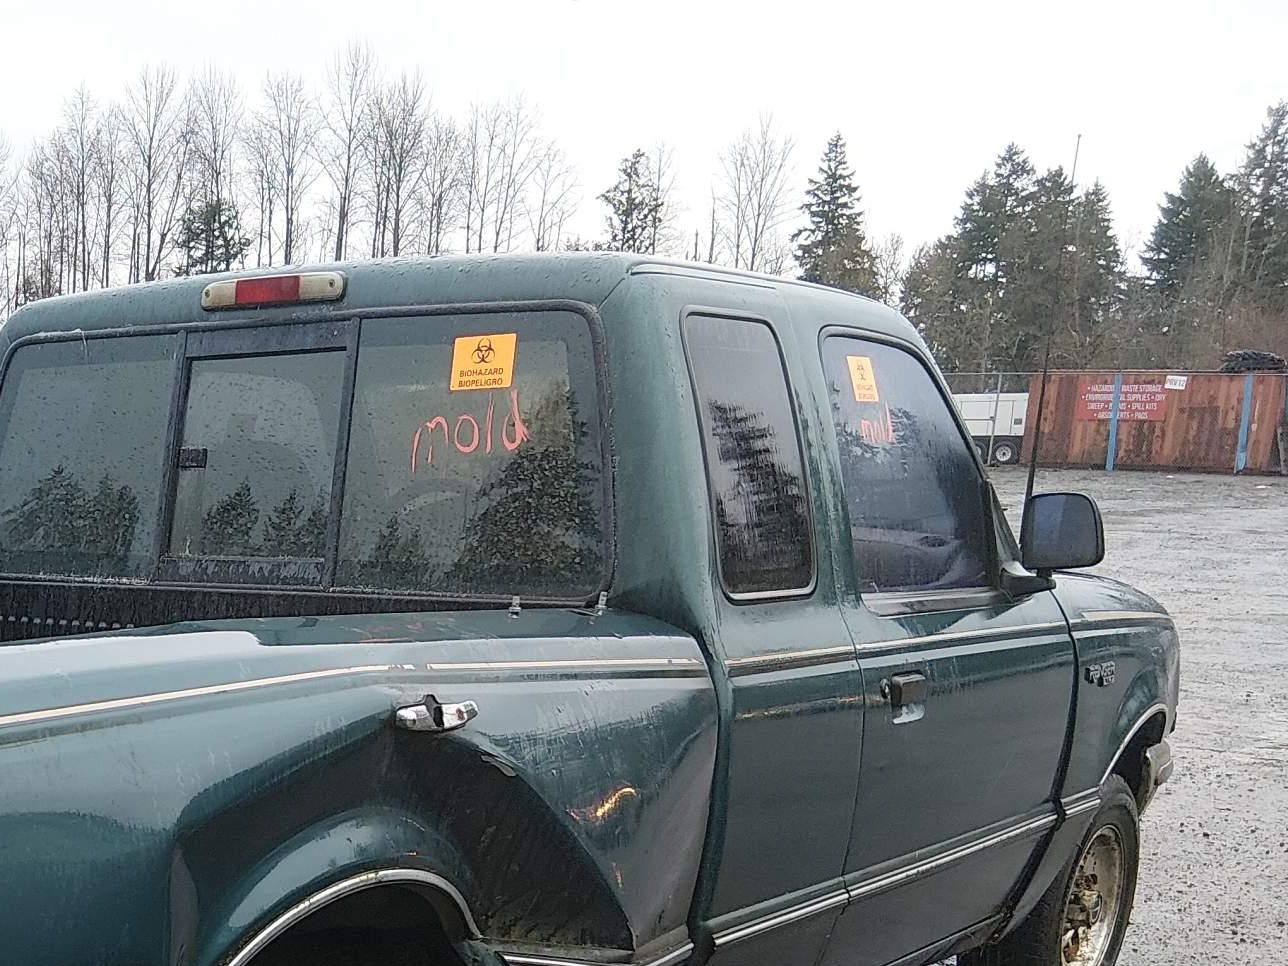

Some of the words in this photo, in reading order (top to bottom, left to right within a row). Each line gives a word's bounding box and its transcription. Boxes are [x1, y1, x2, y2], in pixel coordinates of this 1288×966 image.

[459, 367, 504, 378] BIOHAZARD
[458, 377, 503, 388] BIOPELIGRO
[410, 389, 533, 473] mold
